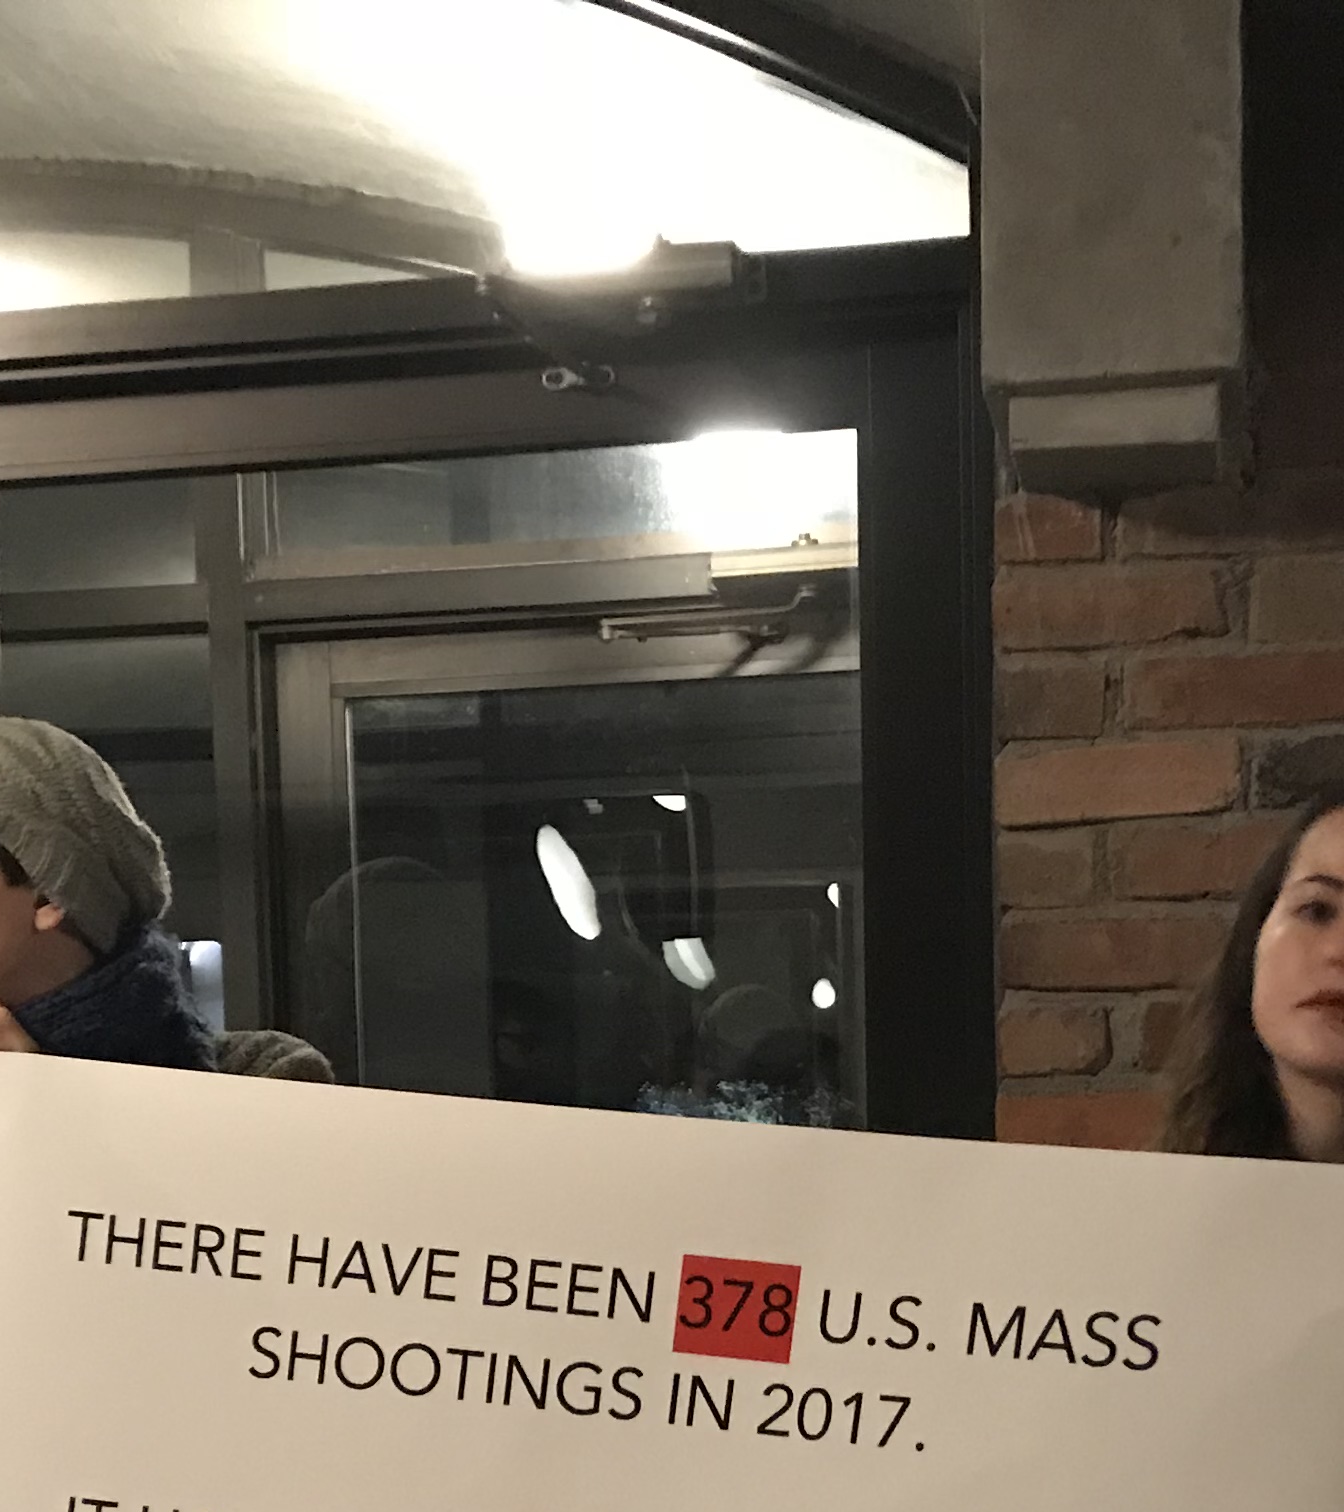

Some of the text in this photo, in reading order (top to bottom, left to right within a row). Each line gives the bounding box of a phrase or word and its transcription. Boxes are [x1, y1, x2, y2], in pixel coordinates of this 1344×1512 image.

[67, 1209, 1162, 1372] THERE HAVE BEEN 378 U.S. MASS
[248, 1326, 925, 1453] SHOOTINGS IN 2017.
